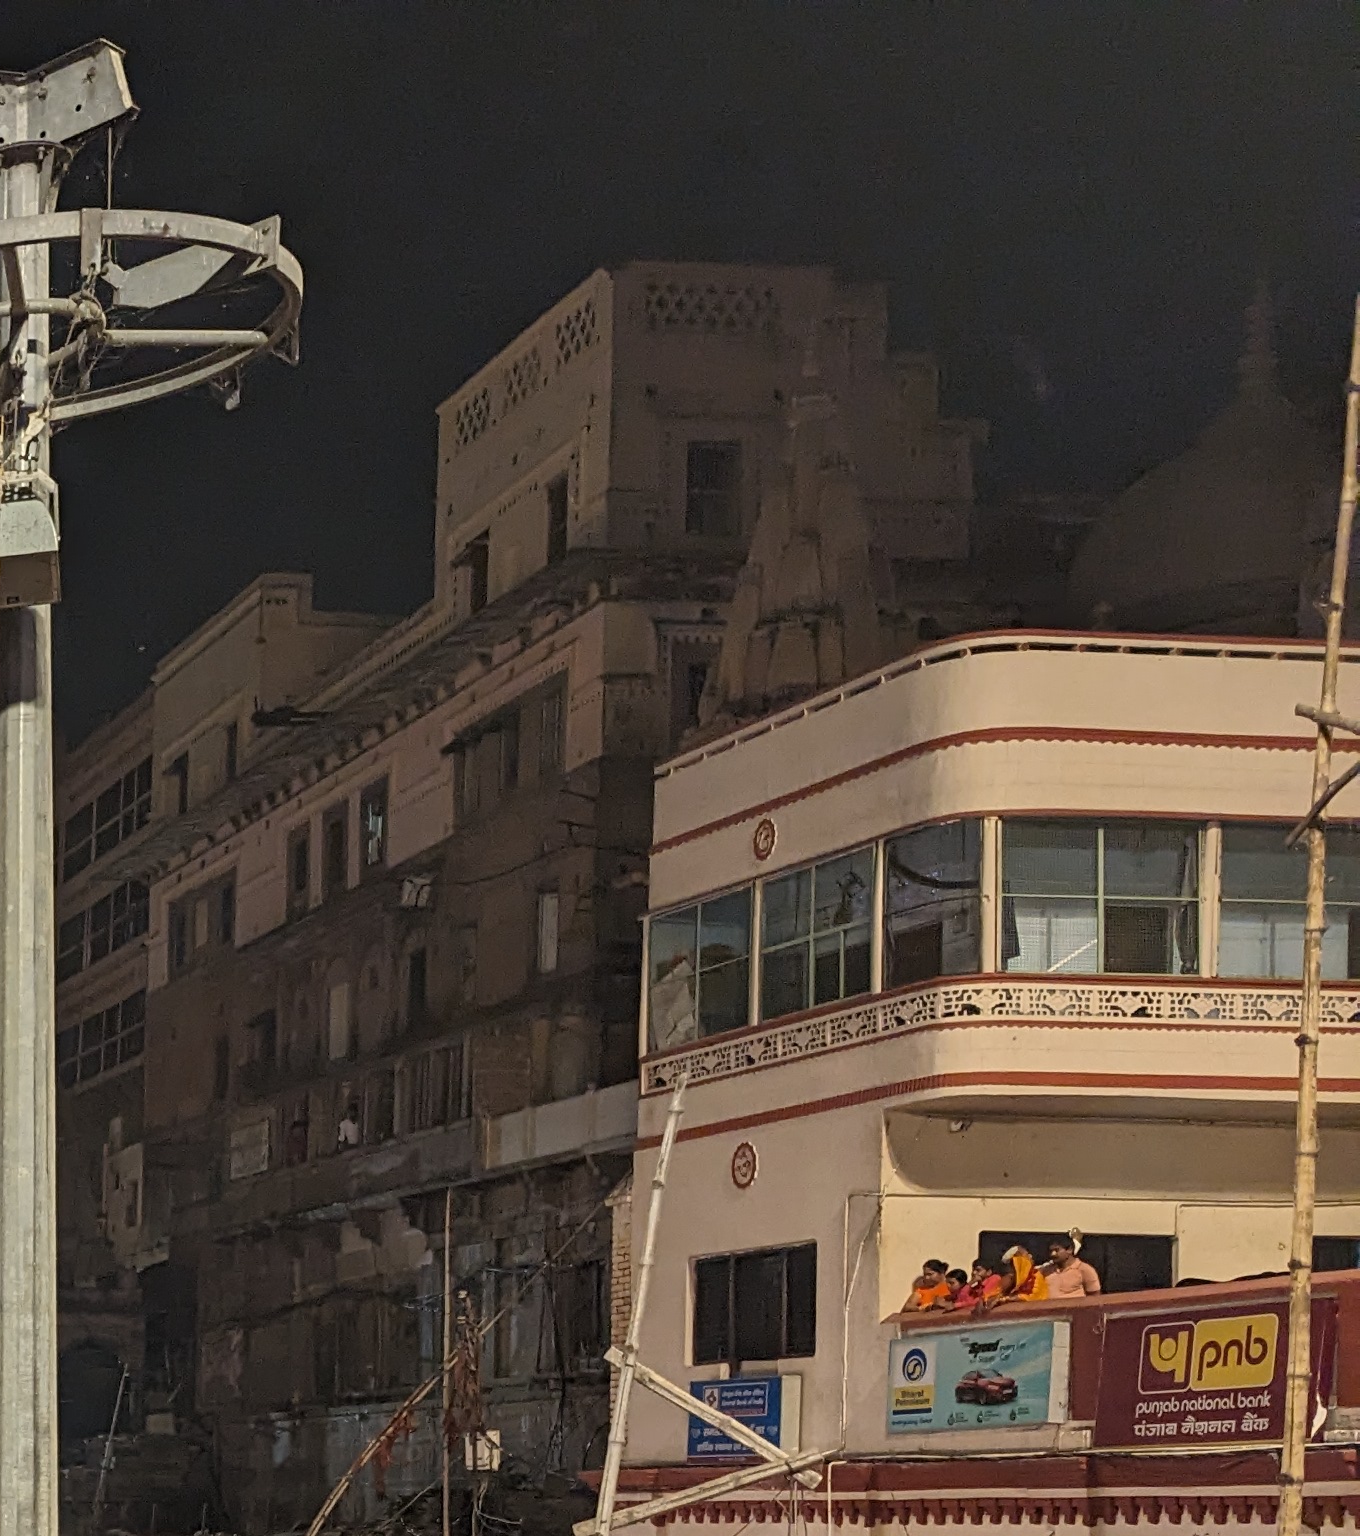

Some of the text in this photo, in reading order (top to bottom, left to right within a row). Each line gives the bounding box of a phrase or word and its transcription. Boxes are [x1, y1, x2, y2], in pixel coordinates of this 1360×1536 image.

[1197, 1325, 1268, 1381] pnb
[1135, 1390, 1272, 1418] punjab national bank
[1133, 1411, 1270, 1437] पंजाब नैशनल बैंक
